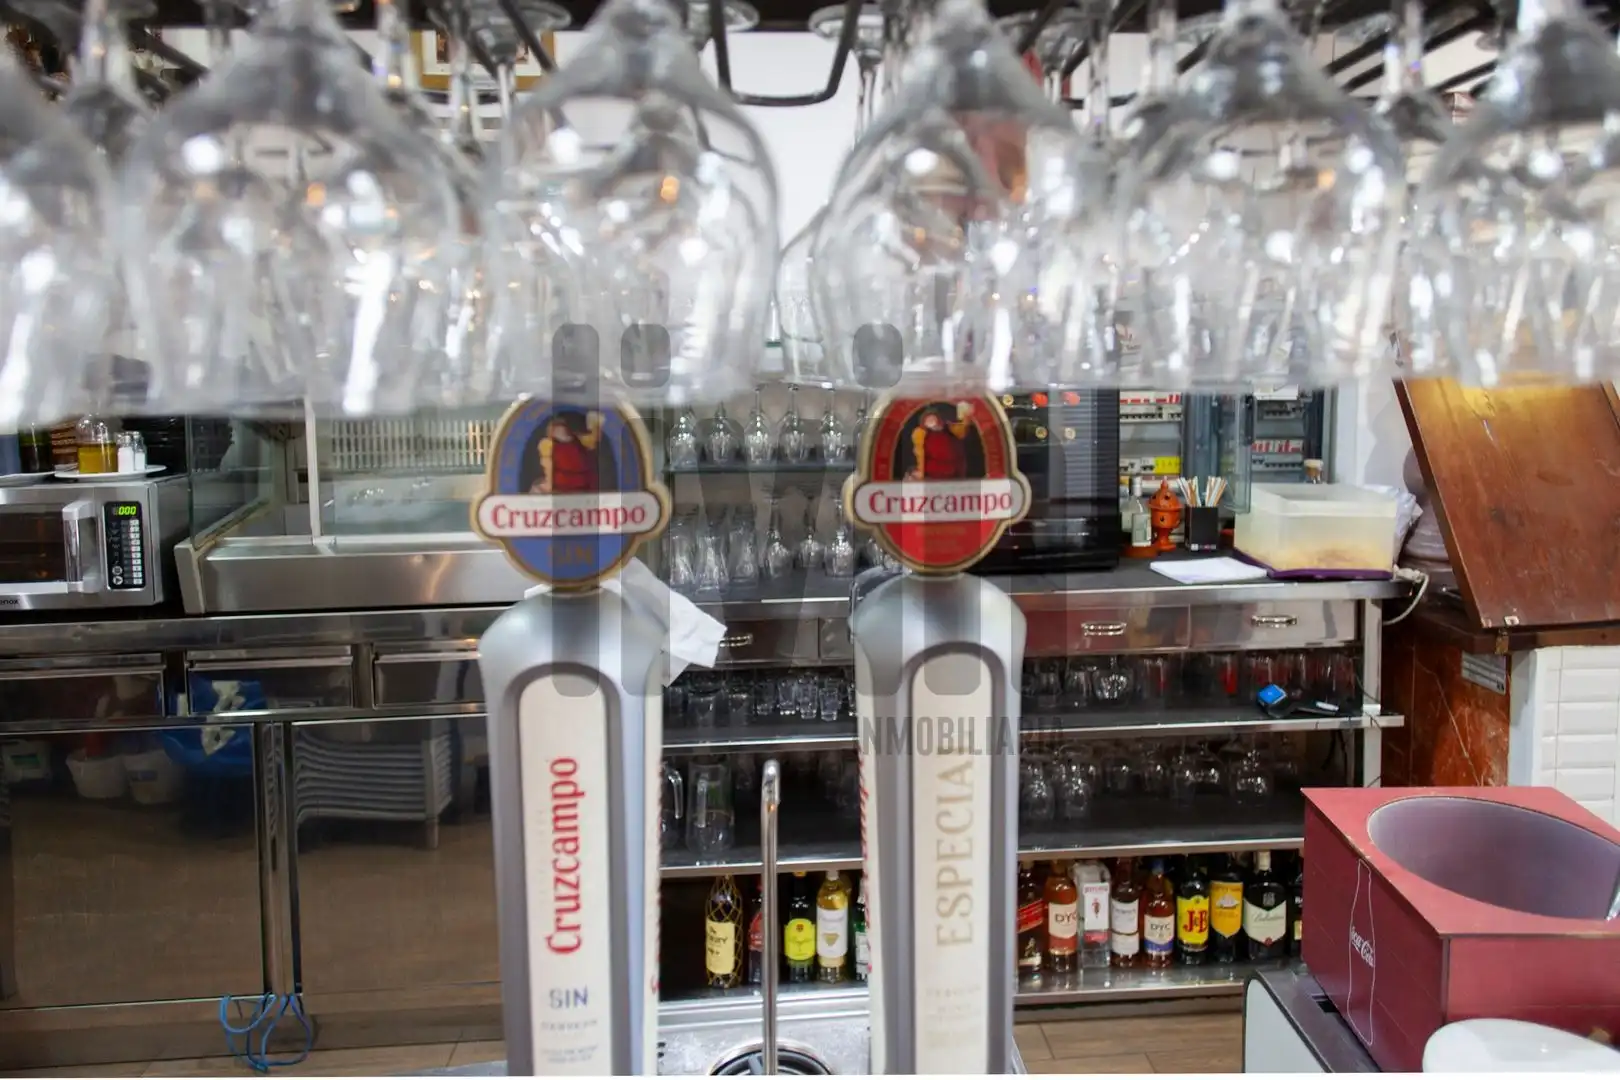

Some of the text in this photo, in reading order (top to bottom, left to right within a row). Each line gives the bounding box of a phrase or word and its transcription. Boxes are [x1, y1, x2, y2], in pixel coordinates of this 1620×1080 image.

[868, 489, 1013, 515] Cruzcampo
[490, 503, 646, 530] Cruzcampo
[545, 756, 586, 955] Cruzcampo
[547, 984, 589, 1010] SIN
